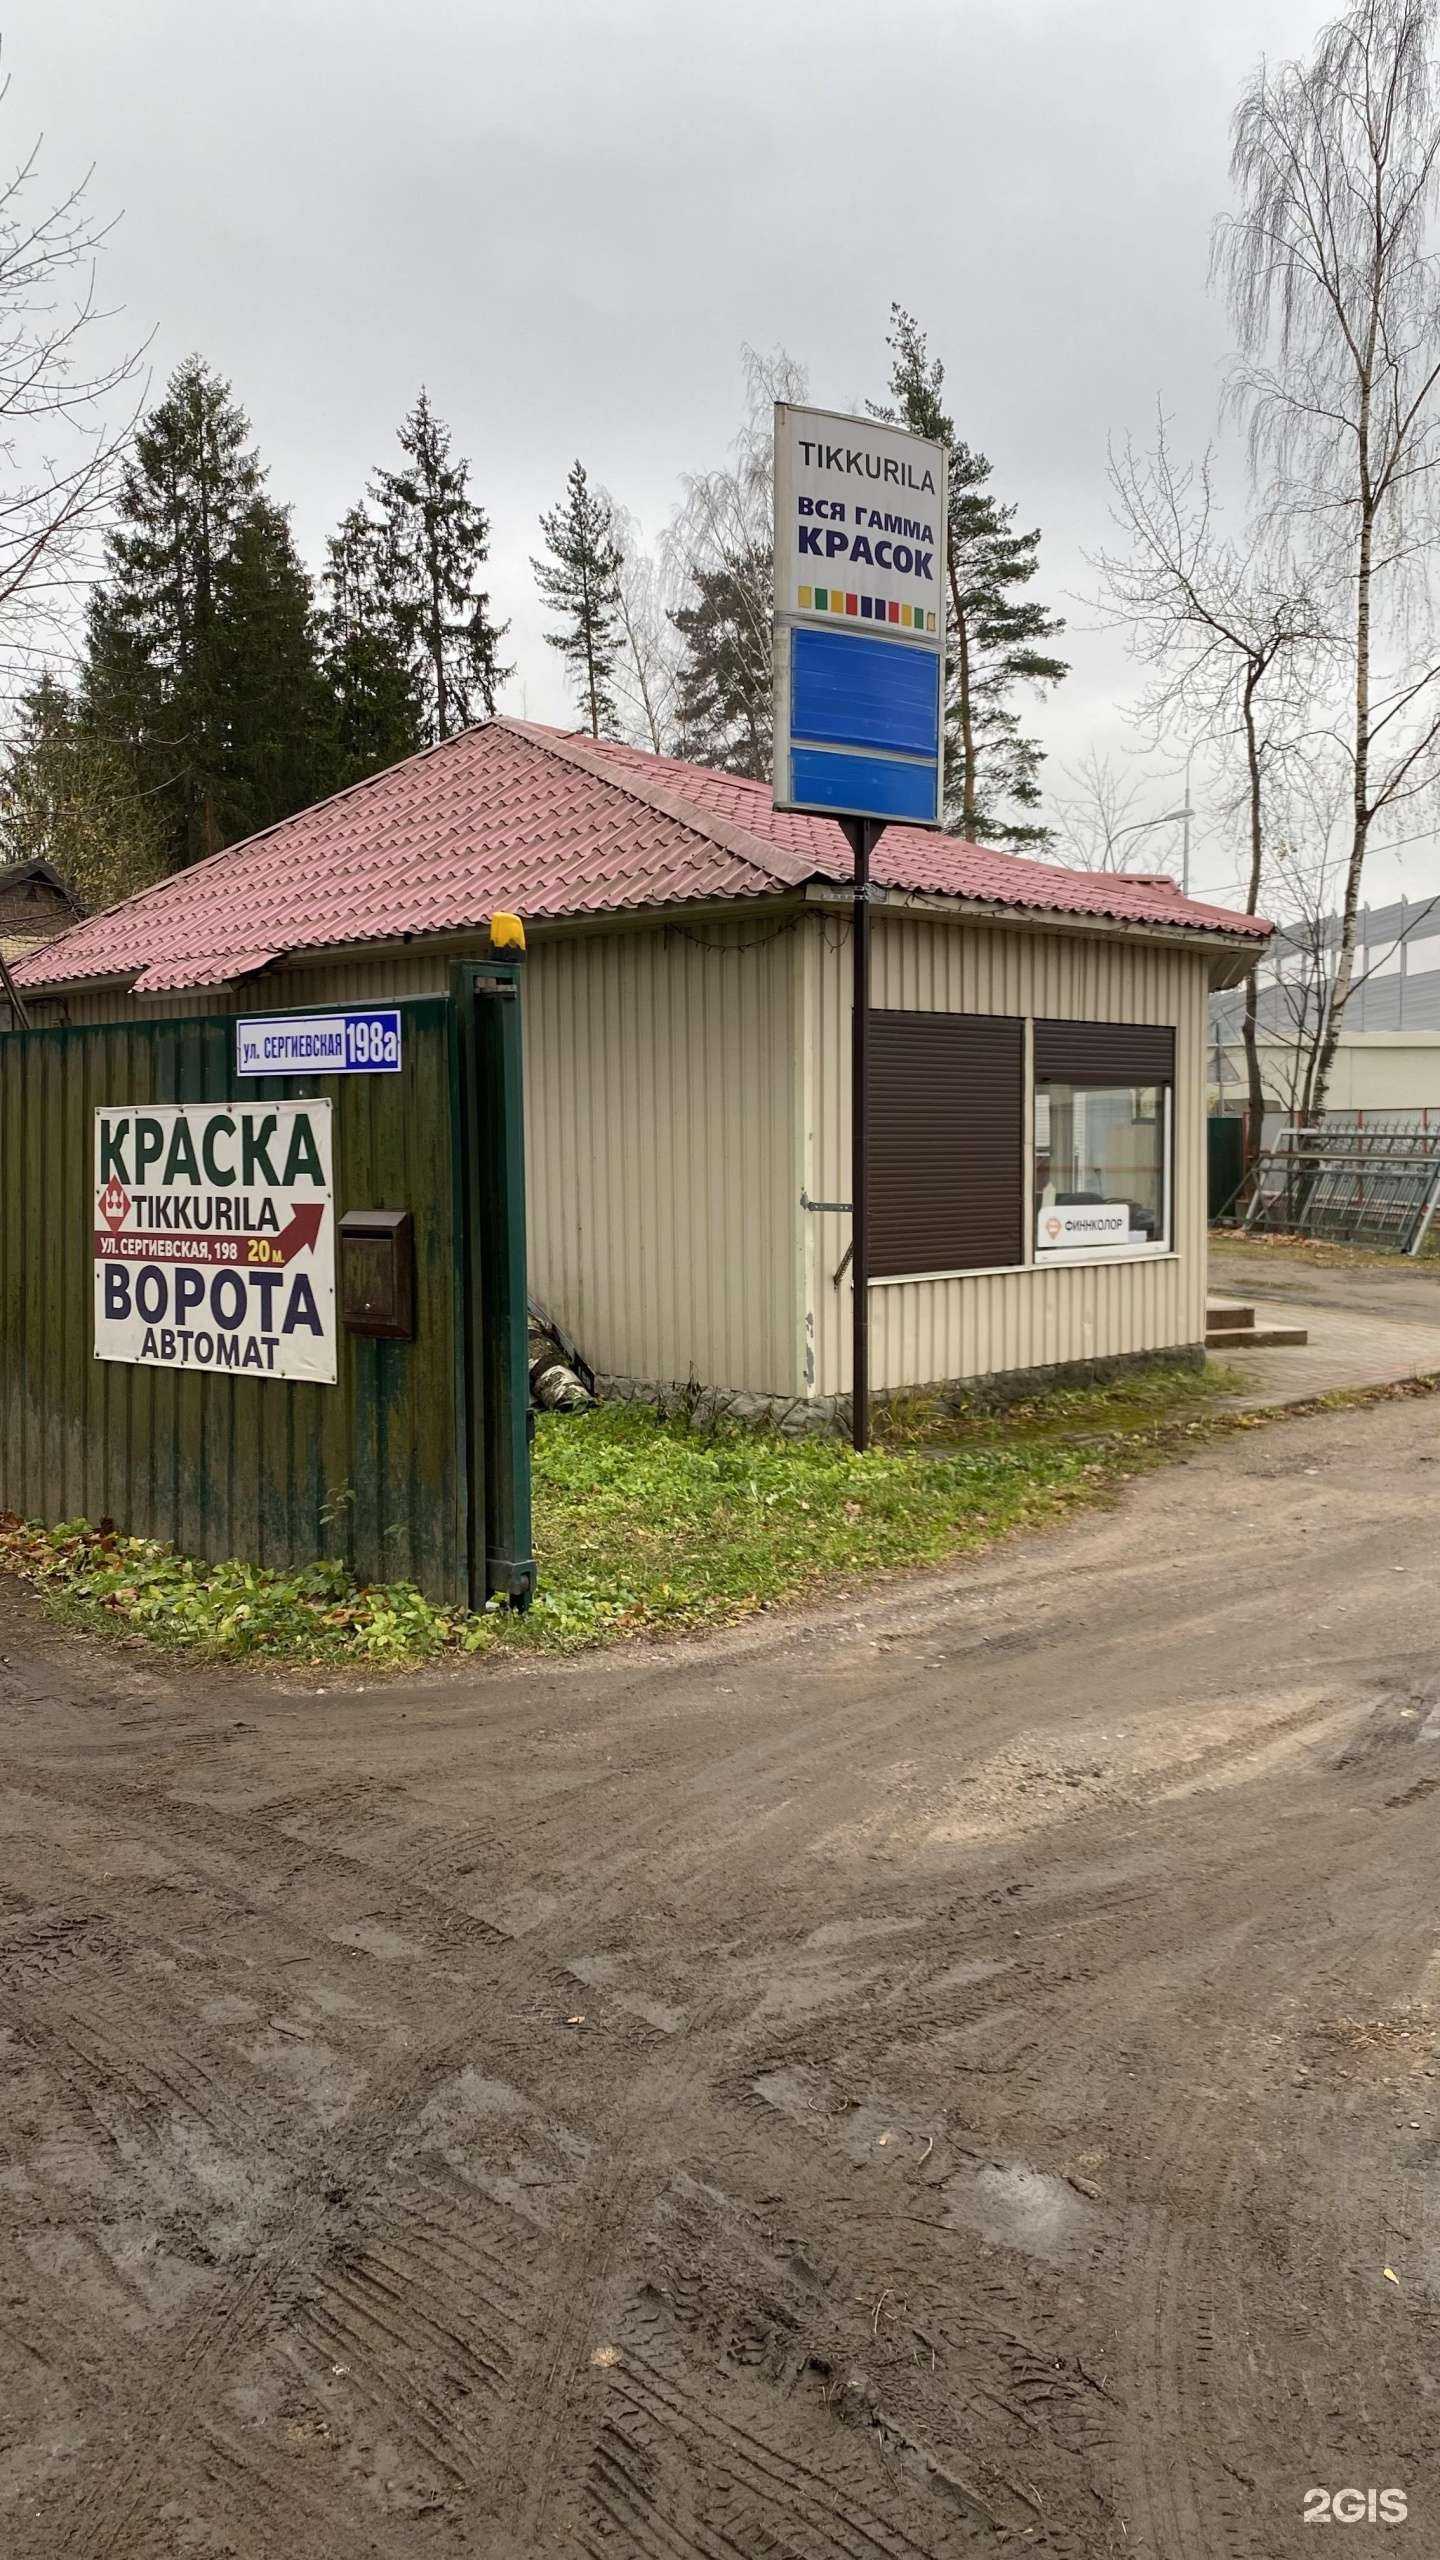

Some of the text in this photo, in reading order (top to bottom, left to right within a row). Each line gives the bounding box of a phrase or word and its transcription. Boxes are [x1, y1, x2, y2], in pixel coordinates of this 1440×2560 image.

[799, 441, 935, 495] TIKKURILA
[798, 496, 934, 545] ВСЯ ГАММА
[798, 525, 933, 581] КРАСОК
[243, 1021, 398, 1064] ул. СЕРГИЕВСКАЯ 198а
[100, 1113, 326, 1187] КРАСКА
[131, 1195, 280, 1232] TIKKURILA
[1065, 1218, 1122, 1232] ФИННКОЛОР
[100, 1237, 119, 1254] УЛ.
[120, 1238, 212, 1261] СЕРГИЕВСКАЯ,
[214, 1242, 238, 1260] 198
[247, 1239, 271, 1262] 20
[104, 1263, 324, 1336] ВОРОТА
[141, 1328, 279, 1370] АВТОМАТ
